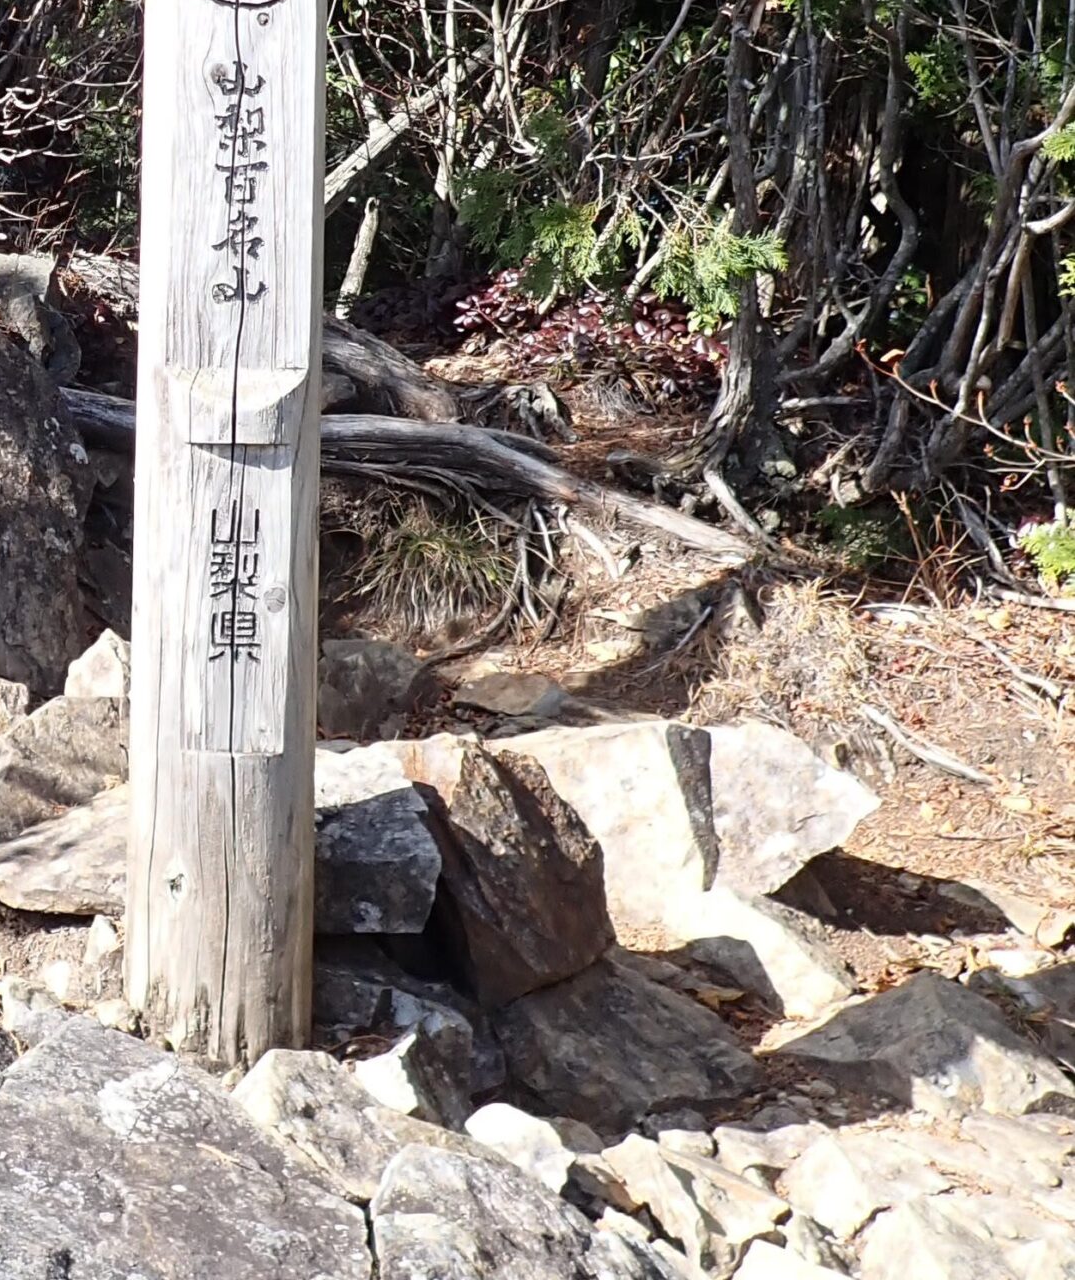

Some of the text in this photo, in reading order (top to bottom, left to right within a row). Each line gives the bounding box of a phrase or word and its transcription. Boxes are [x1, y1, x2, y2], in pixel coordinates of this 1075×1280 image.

[212, 60, 269, 302] 山梨百名山
[208, 499, 261, 662] 山梨県
